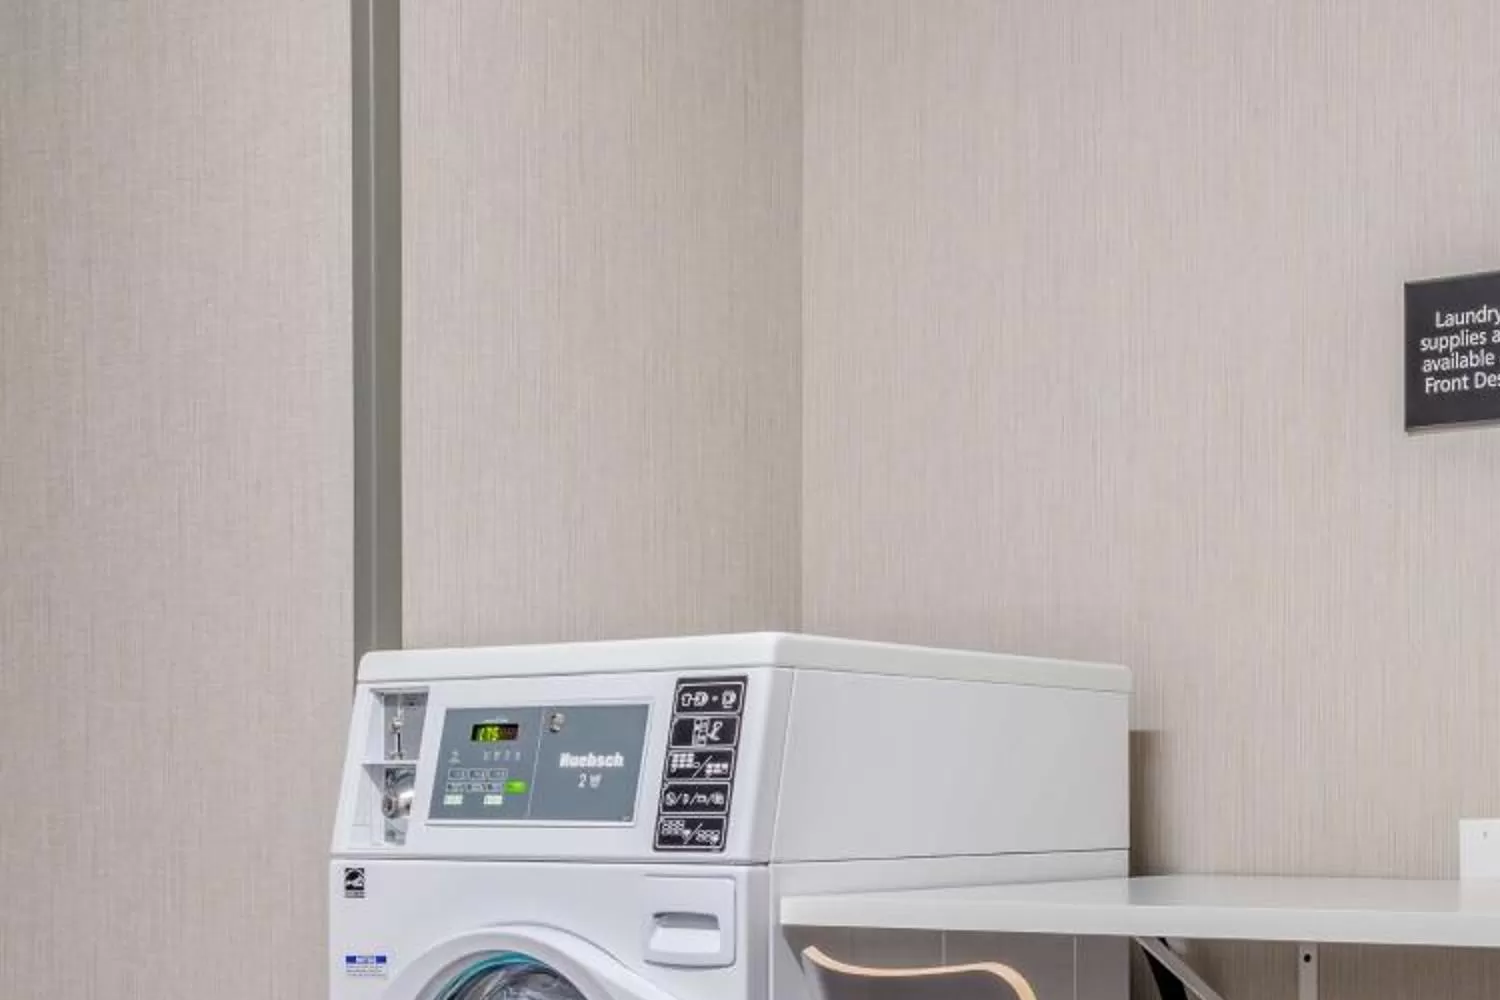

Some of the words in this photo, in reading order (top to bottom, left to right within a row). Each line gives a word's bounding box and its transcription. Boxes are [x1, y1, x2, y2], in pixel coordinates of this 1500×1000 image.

[1420, 328, 1487, 353] supplies
[1423, 348, 1495, 373] available
[1425, 374, 1469, 394] Front
[559, 751, 625, 768] Huebsch
